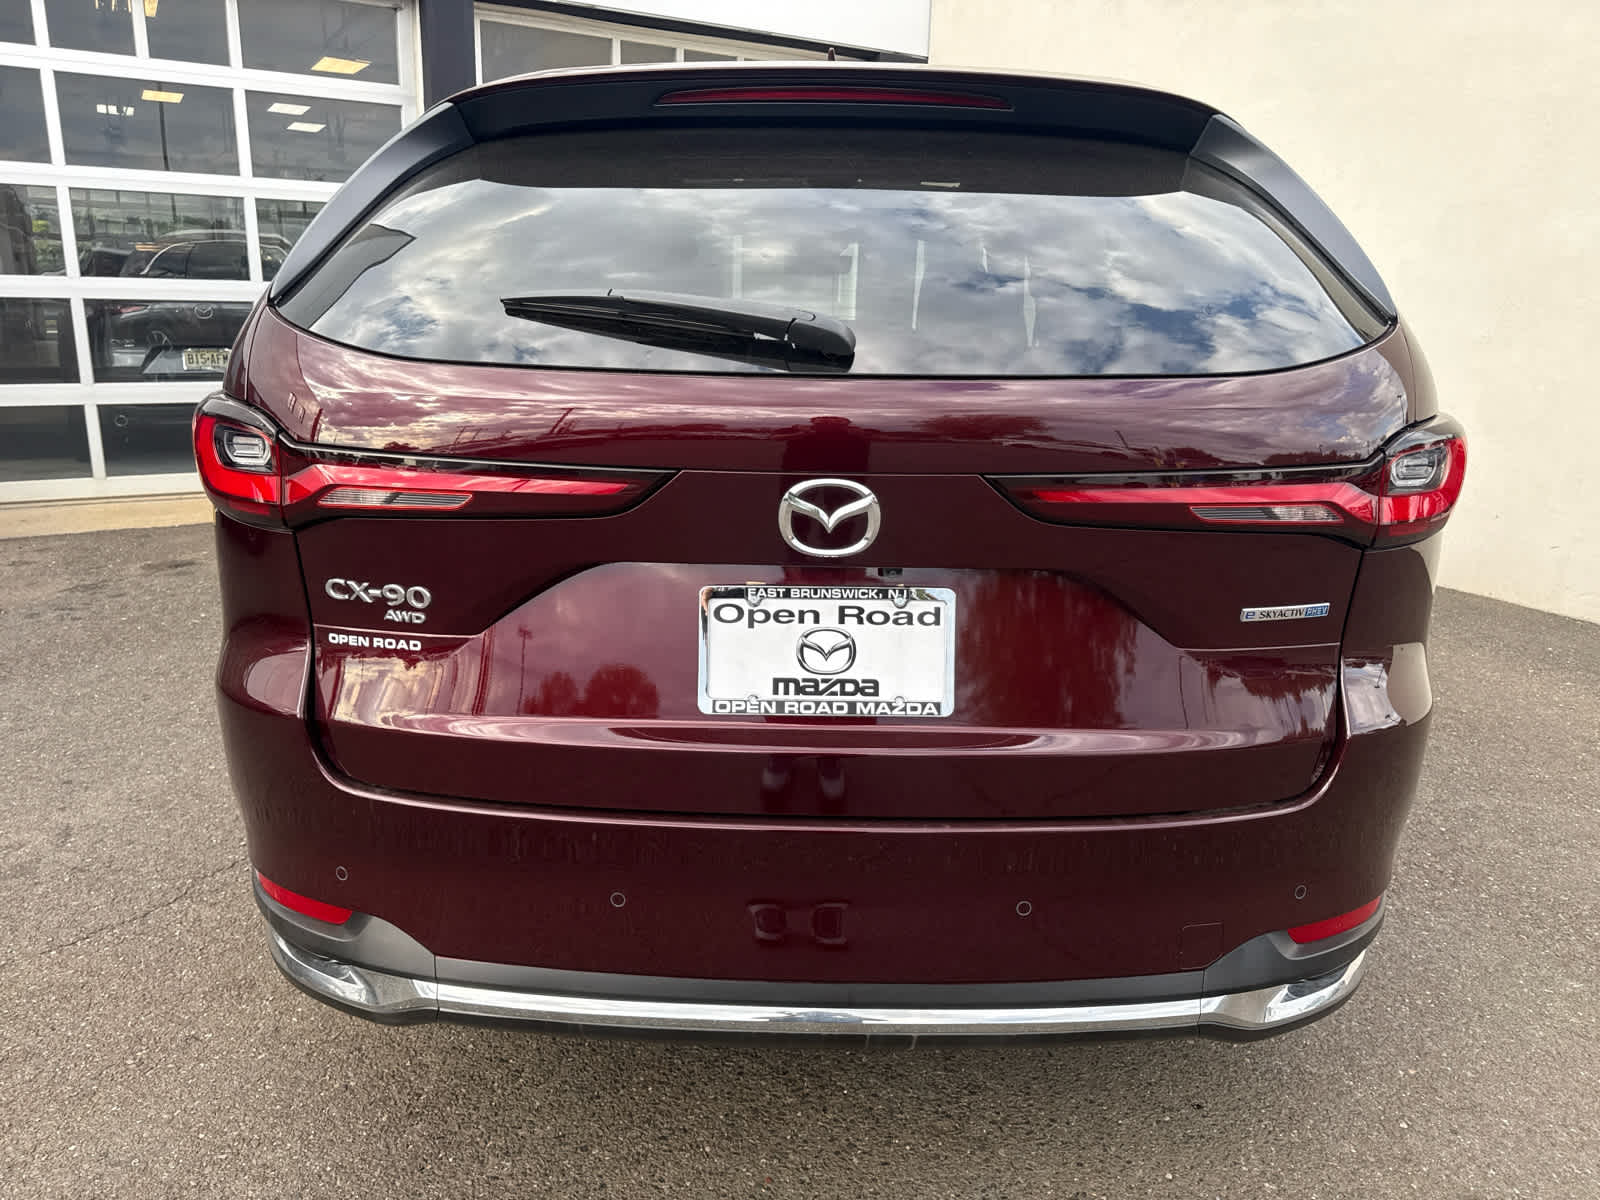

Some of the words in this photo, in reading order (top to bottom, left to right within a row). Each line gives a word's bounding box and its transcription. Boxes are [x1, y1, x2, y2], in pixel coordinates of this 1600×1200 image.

[325, 578, 431, 609] CX-90
[747, 587, 786, 600] EAST
[789, 588, 882, 600] BRUNSWICK,
[384, 609, 426, 624] AWD
[713, 603, 820, 628] Open
[837, 605, 941, 626] Road
[1259, 607, 1304, 619] SKYACTIV
[328, 633, 370, 647] OPEN
[372, 637, 422, 651] ROAD
[714, 700, 777, 713] OPEN
[784, 701, 849, 714] ROAD
[855, 702, 938, 715] MAZDA
